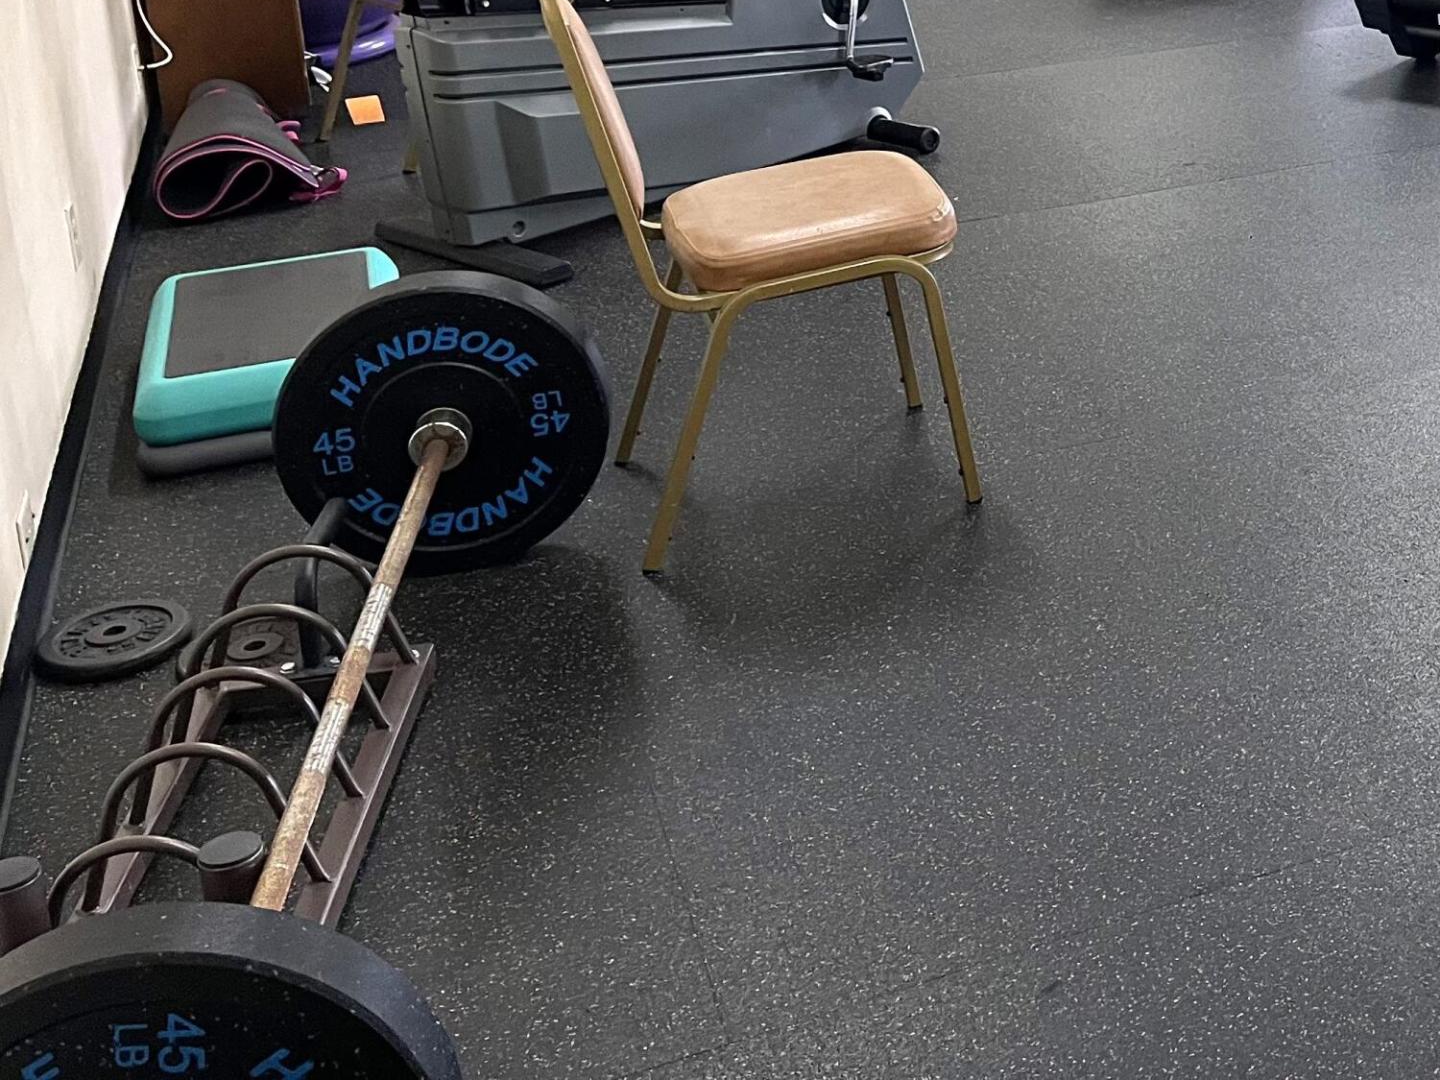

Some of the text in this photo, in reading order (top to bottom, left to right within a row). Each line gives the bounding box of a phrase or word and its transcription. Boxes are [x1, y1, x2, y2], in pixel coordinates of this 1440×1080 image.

[330, 326, 539, 407] HANDBODE
[531, 390, 563, 410] LB
[313, 428, 356, 455] 45
[530, 410, 571, 437] 45
[321, 455, 354, 476] LB
[348, 456, 553, 536] HANDBDE
[111, 1023, 149, 1068] LB
[156, 1013, 207, 1073] 45
